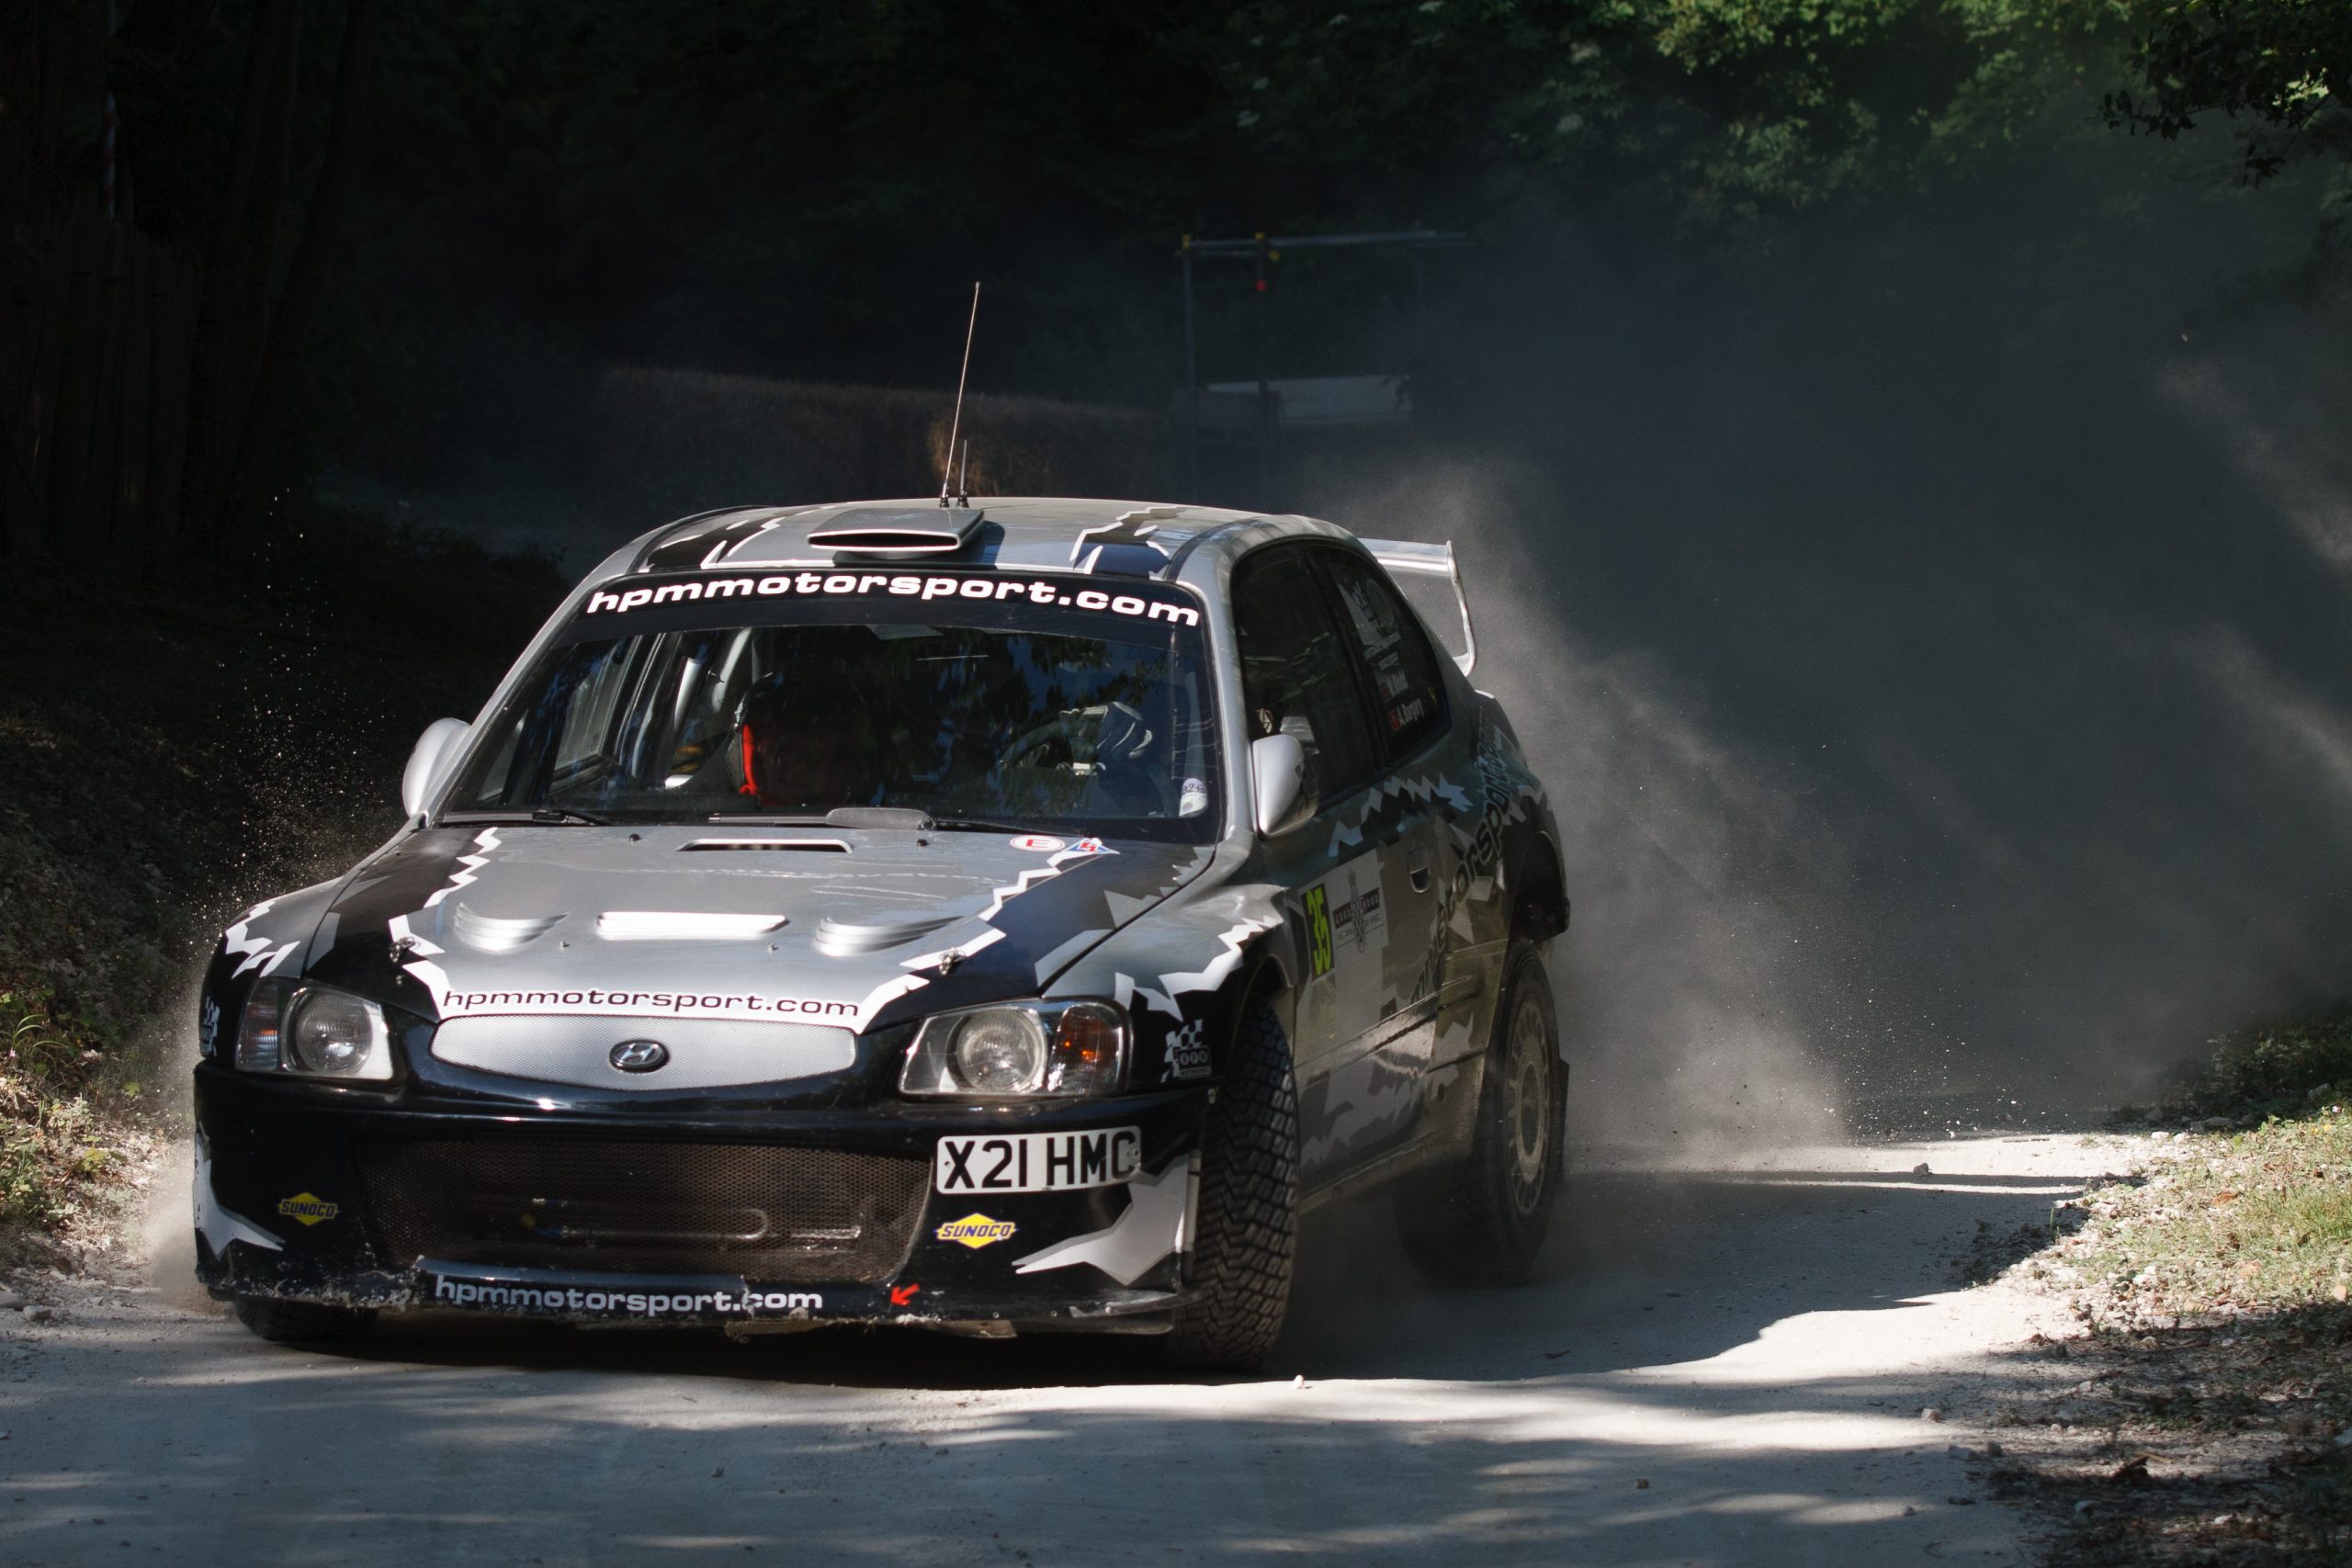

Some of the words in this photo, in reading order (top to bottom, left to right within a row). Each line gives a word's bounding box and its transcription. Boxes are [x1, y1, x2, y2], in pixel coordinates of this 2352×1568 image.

[586, 575, 1198, 626] hpmmotorsport.com
[1306, 886, 1331, 976] 35
[443, 989, 860, 1017] hpmmotorsport.com
[944, 1138, 1028, 1189] X21
[1046, 1131, 1136, 1187] HMC
[280, 1201, 336, 1219] SUNOCO
[941, 1224, 1013, 1238] SUNOCO
[435, 1275, 823, 1317] hpmmotorsport.com
